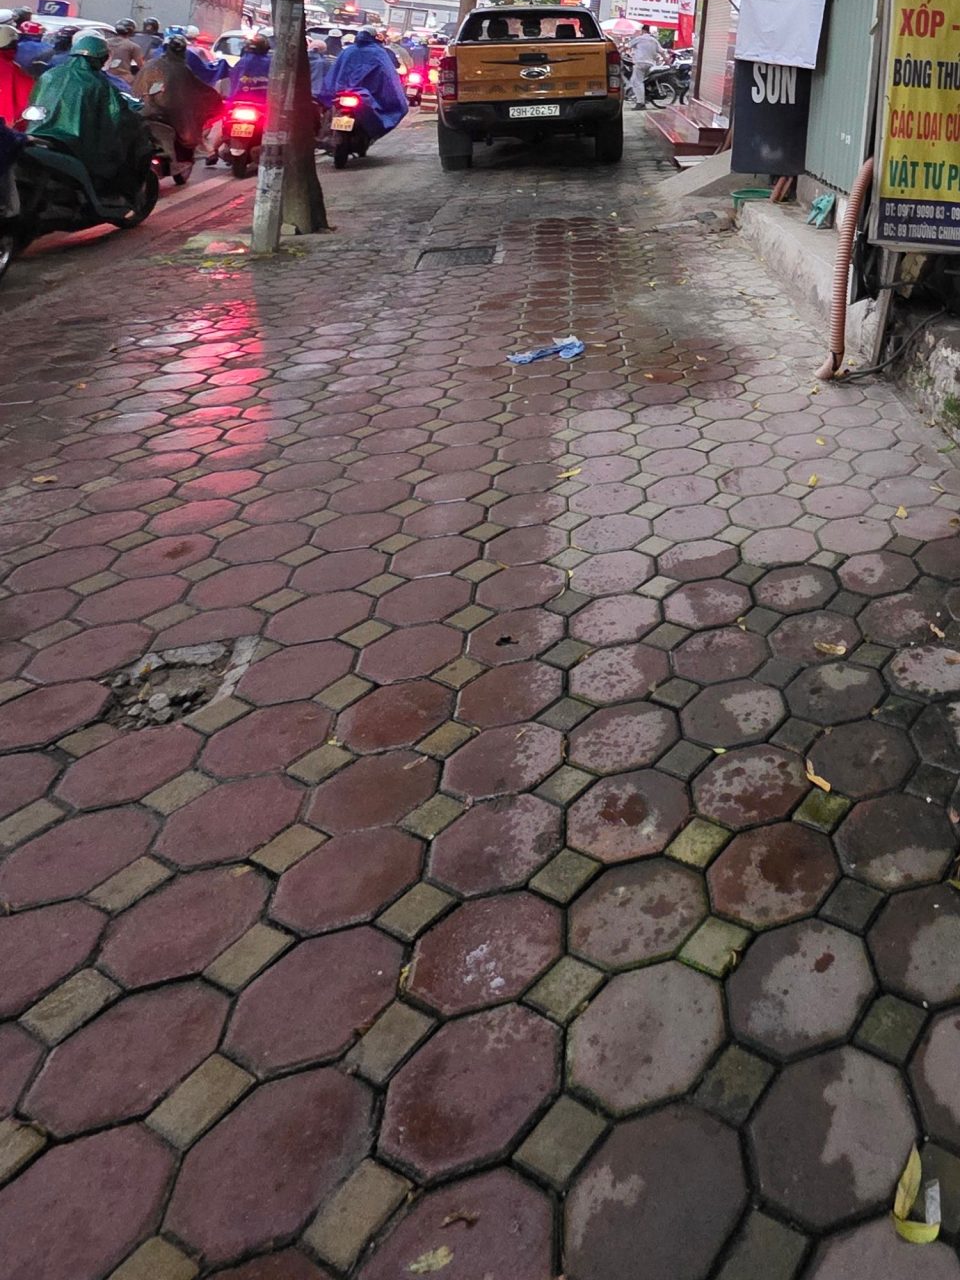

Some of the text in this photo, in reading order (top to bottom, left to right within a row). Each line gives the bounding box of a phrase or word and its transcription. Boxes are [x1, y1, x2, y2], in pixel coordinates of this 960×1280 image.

[899, 0, 945, 38] XỐP
[893, 53, 932, 88] BÔNG
[890, 104, 914, 138] CÁC
[917, 111, 942, 147] LOẠI
[889, 154, 919, 195] VẬT
[924, 160, 945, 190] TƯ
[917, 205, 934, 219] 9090
[908, 221, 937, 239] TRƯỜNG
[938, 226, 960, 240] CHINH
